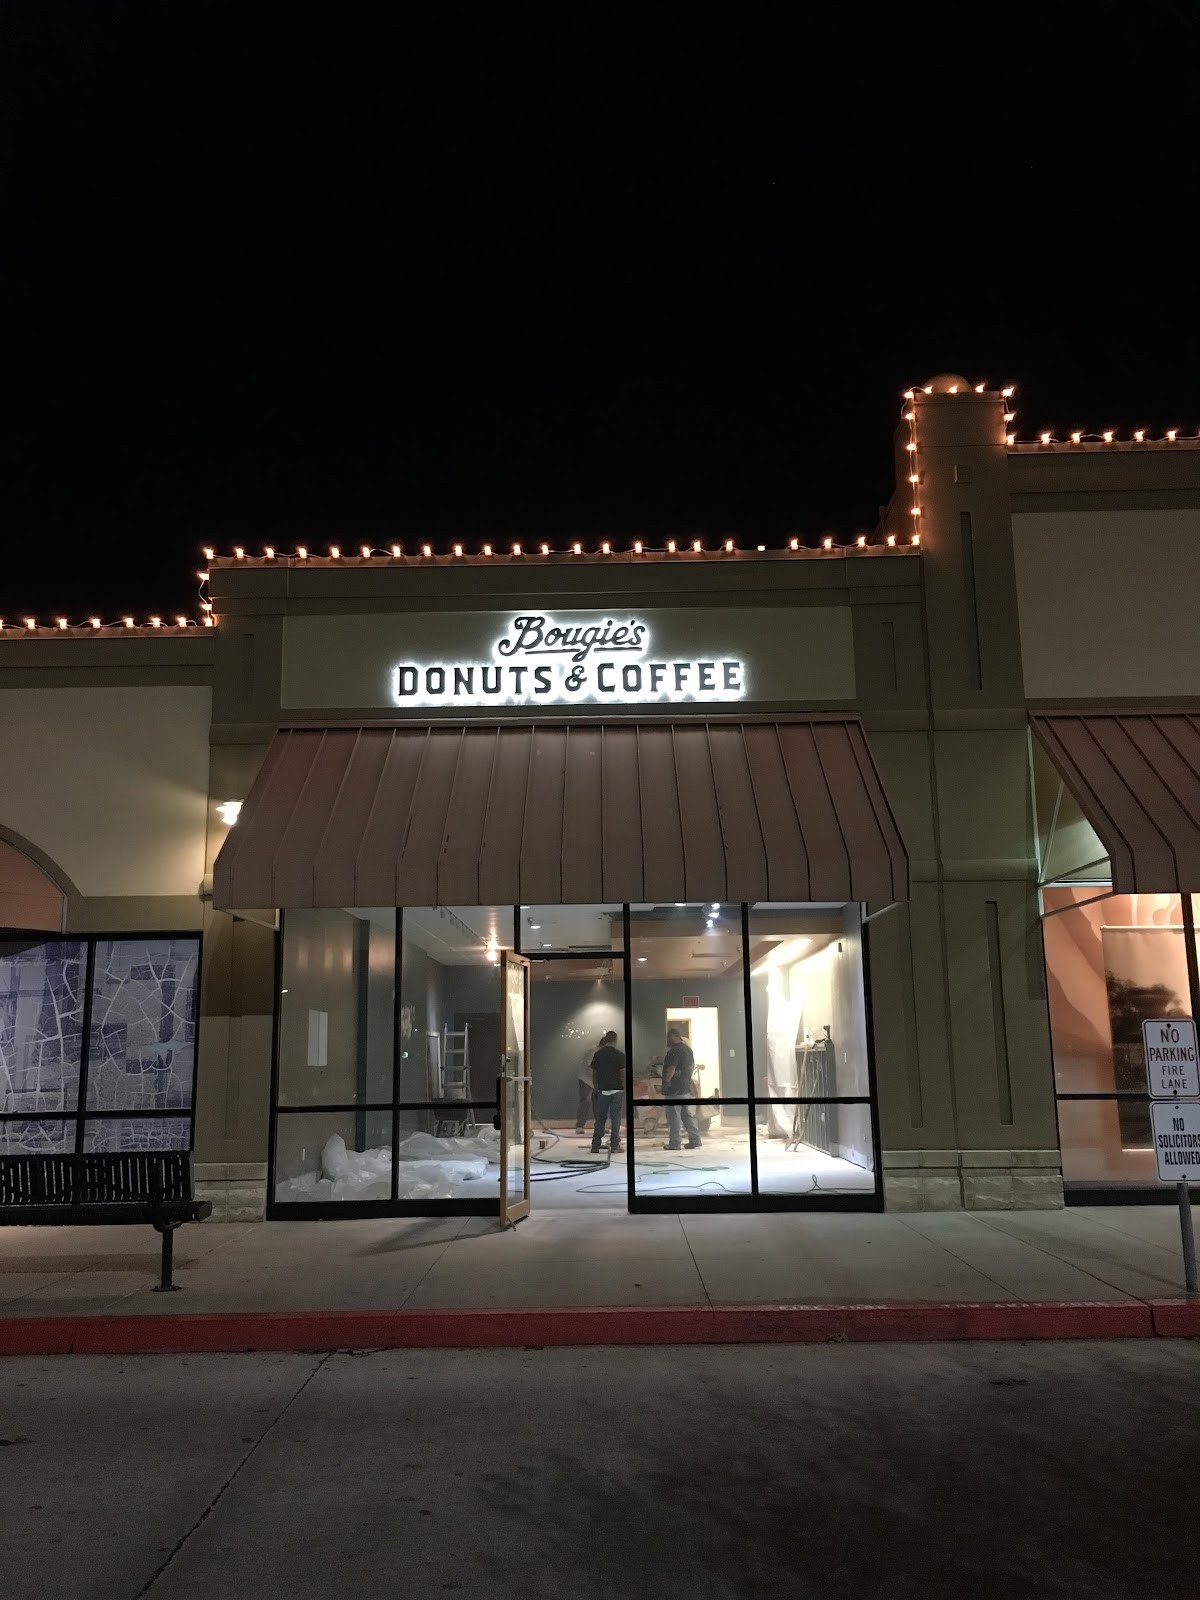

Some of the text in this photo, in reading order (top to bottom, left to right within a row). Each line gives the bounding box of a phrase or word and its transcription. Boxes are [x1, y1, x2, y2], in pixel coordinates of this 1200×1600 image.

[498, 616, 647, 663] Bougie's
[398, 662, 742, 697] DONUTS & COFFEE
[1160, 1029, 1180, 1043] NO
[1149, 1047, 1195, 1062] PARKING
[1161, 1065, 1186, 1076] FIRE
[1161, 1079, 1188, 1089] LANE
[1172, 1117, 1185, 1131] NO
[1158, 1134, 1200, 1148] SOLICITORS
[1164, 1151, 1200, 1165] ALLOWED
